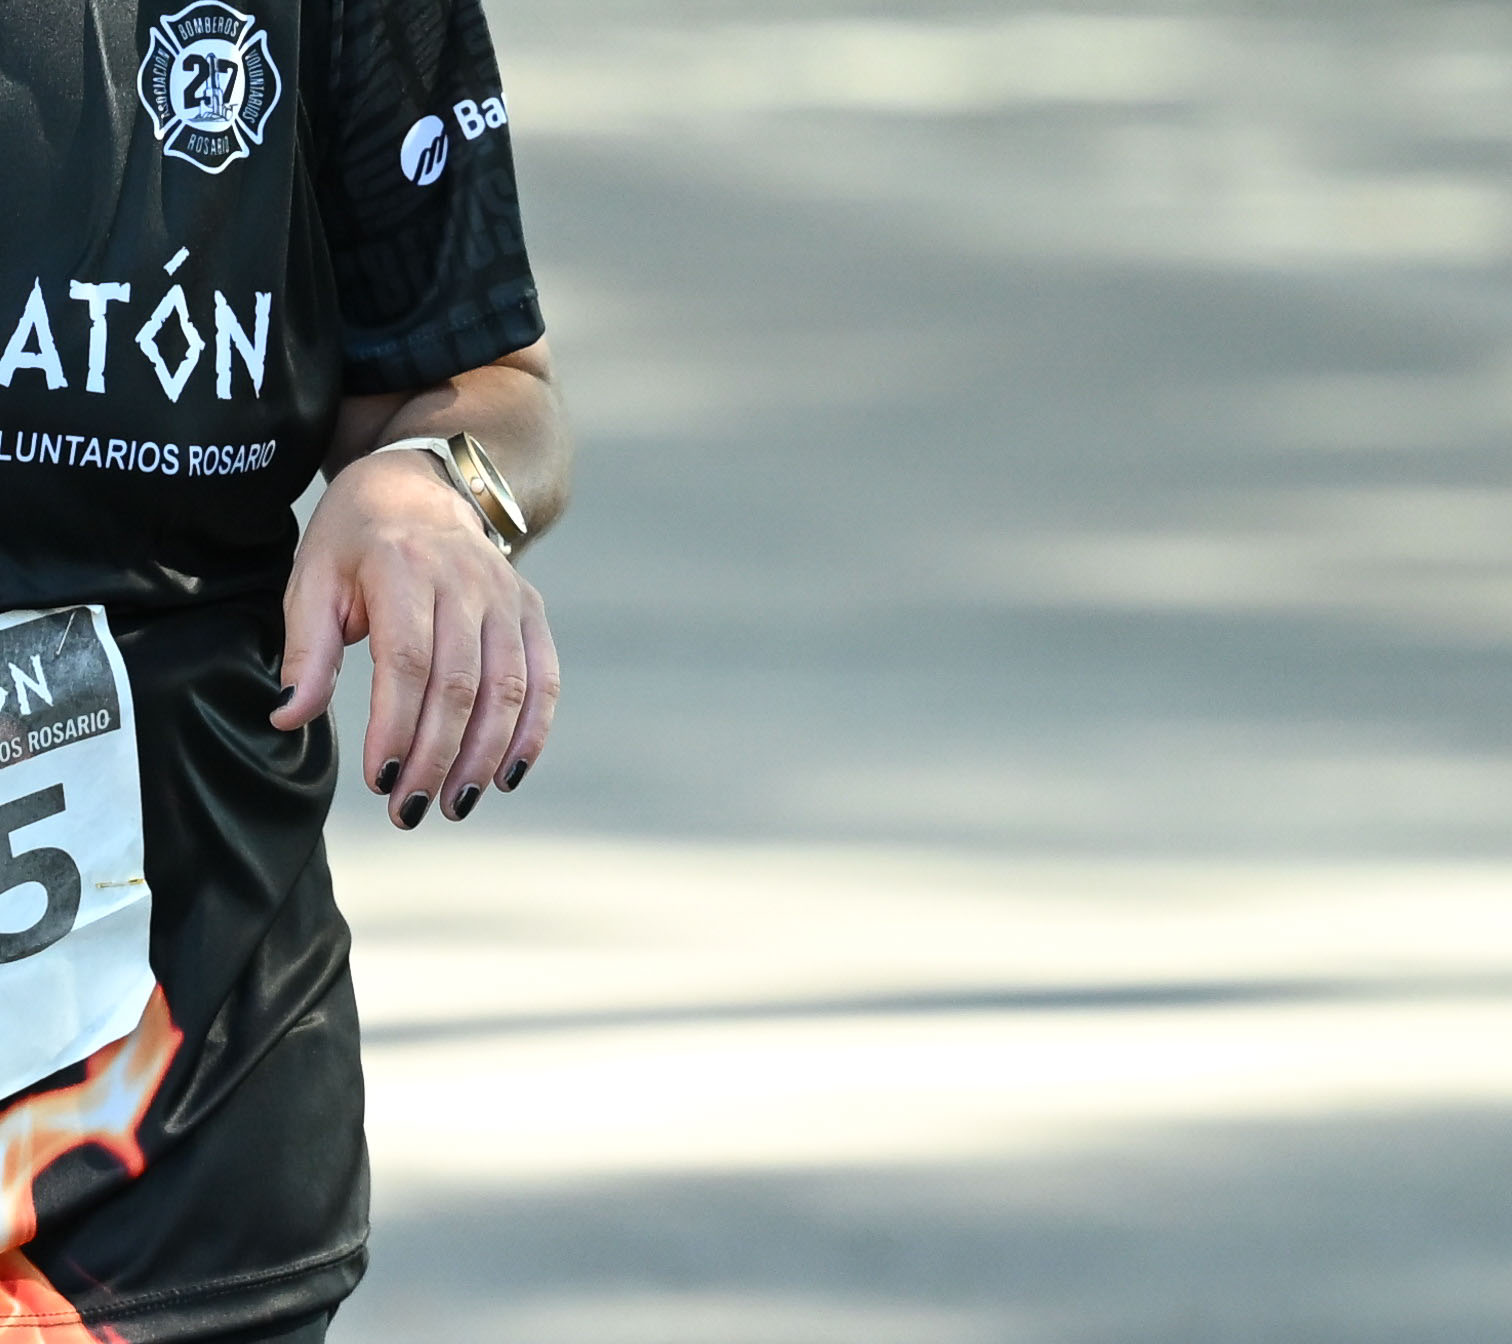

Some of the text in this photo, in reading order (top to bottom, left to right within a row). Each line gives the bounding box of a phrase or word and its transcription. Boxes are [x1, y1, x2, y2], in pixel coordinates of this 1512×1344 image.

[177, 16, 240, 41] BOMBEROS
[182, 53, 239, 110] 27
[242, 48, 265, 125] VOLUNTARIOS
[453, 92, 508, 141] Ba
[187, 133, 230, 156] ROSARIO
[188, 439, 276, 477] ROSARIO
[28, 709, 111, 753] ROSARIO
